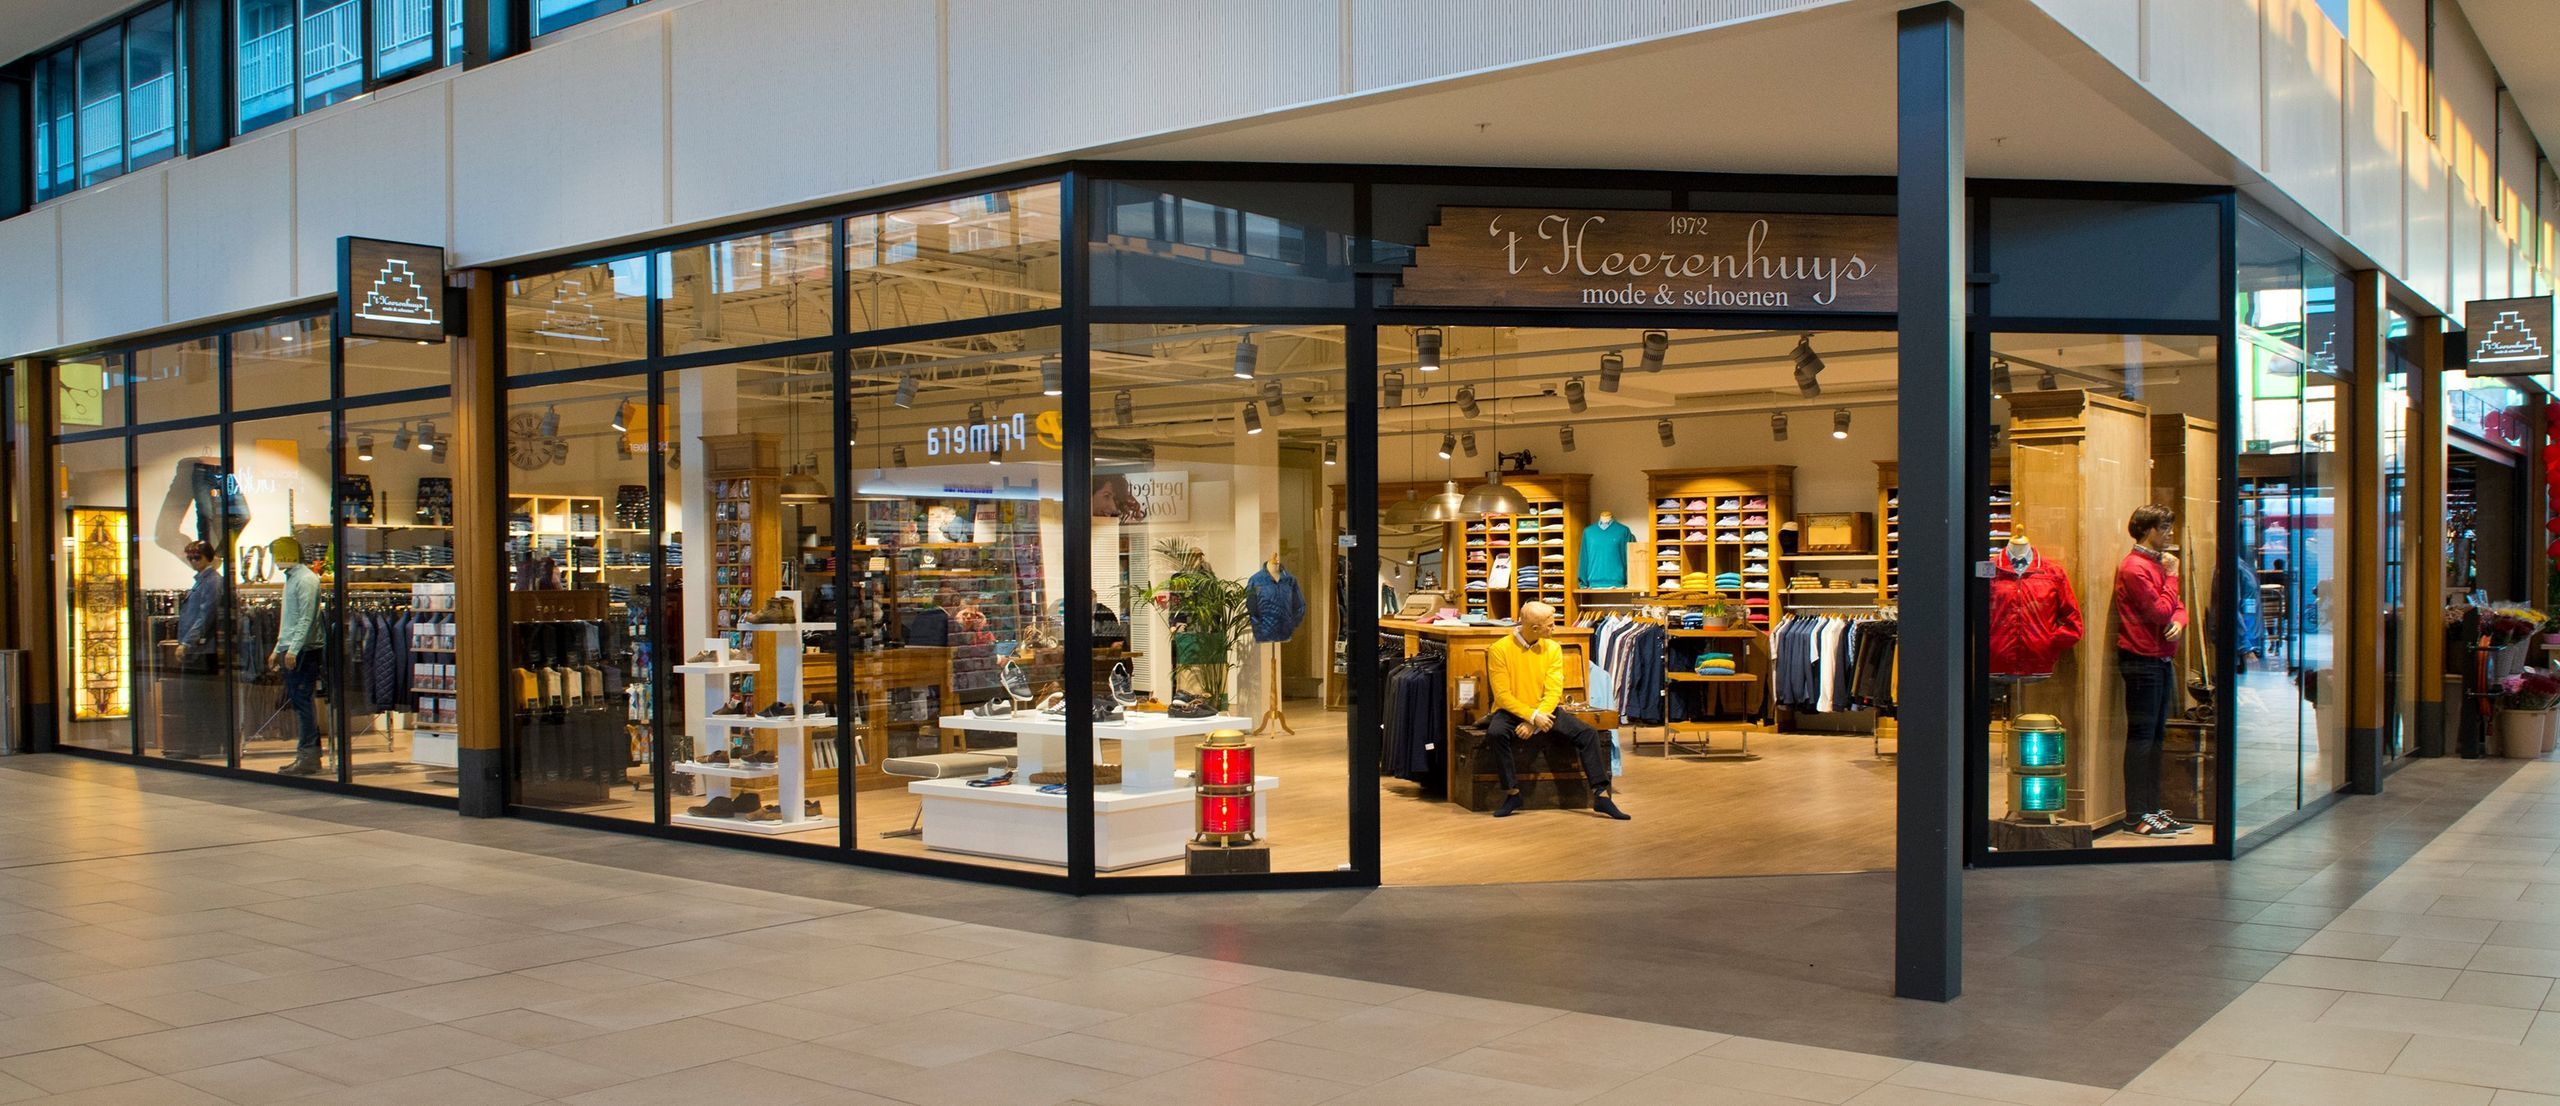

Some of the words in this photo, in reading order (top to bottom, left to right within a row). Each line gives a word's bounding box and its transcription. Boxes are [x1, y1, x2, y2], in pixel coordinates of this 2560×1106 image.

[1667, 215, 1709, 236] 1972
[1538, 214, 1877, 305] Heerenhuys
[1582, 283, 1647, 305] mode
[1653, 284, 1676, 306] &
[1683, 283, 1789, 307] schoenen
